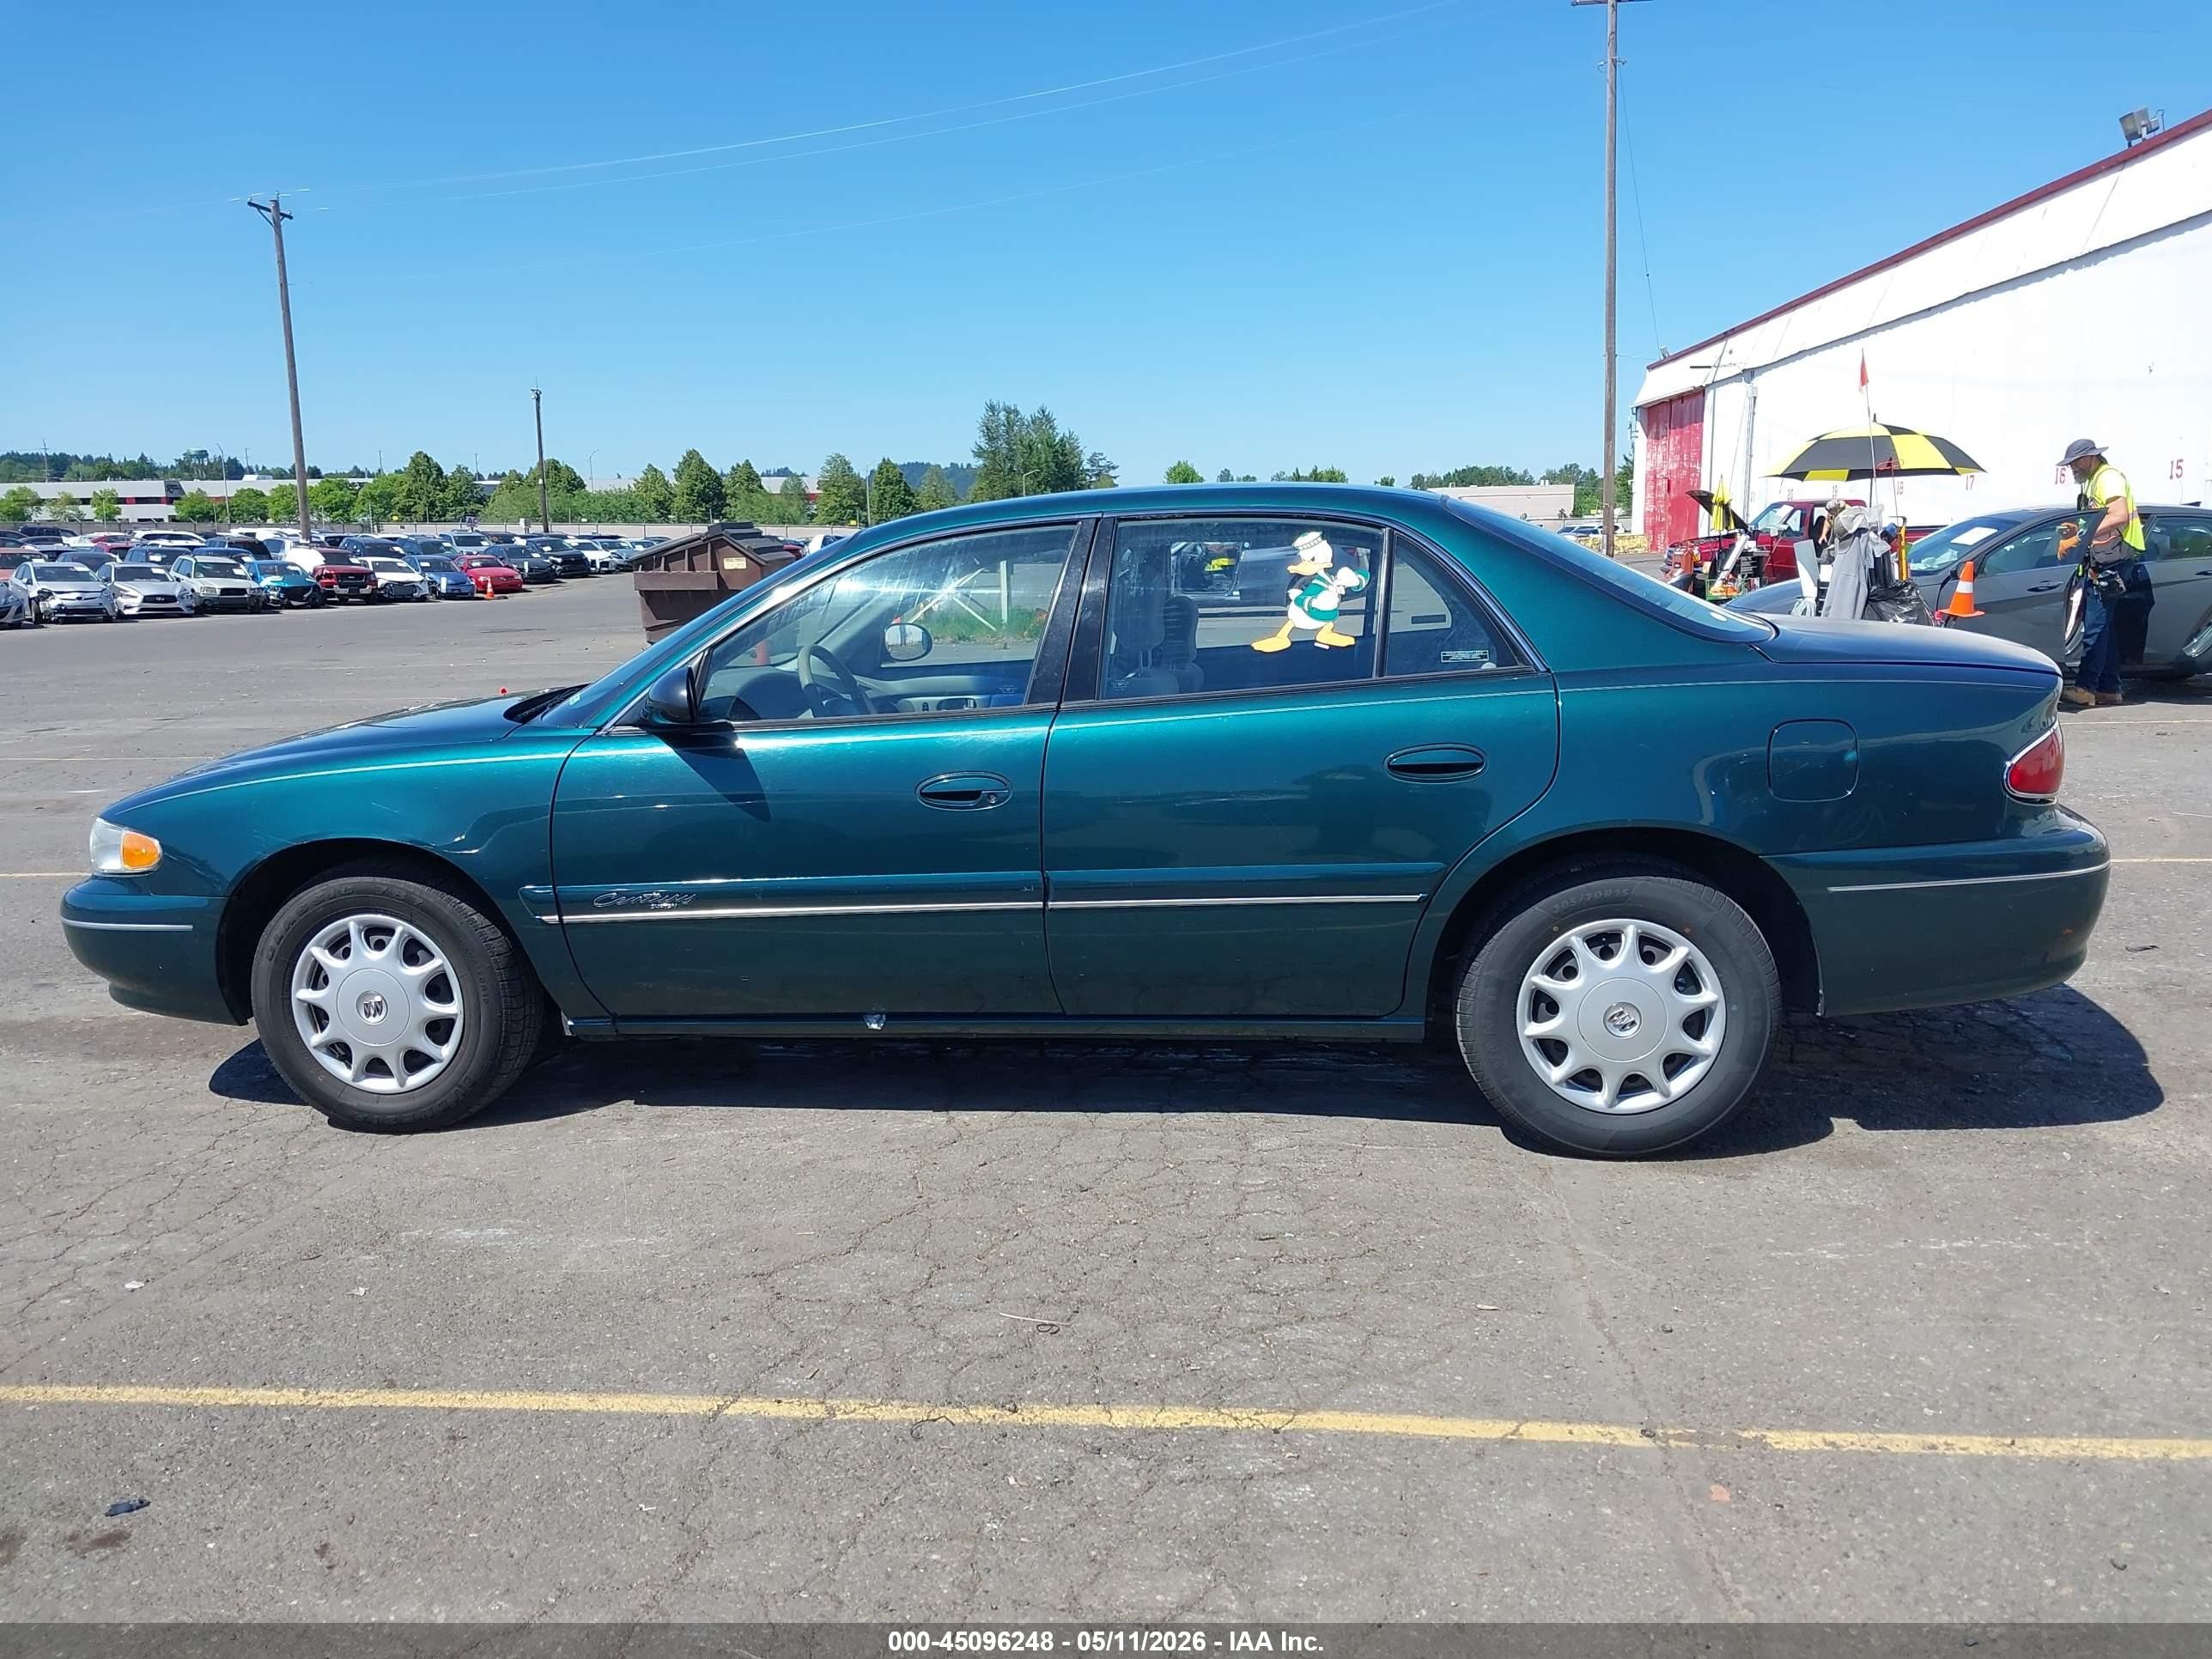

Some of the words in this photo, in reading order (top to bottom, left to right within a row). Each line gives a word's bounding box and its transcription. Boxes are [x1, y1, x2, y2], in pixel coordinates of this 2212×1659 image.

[2055, 466, 2066, 485] 16
[2169, 459, 2185, 480] 15
[1896, 481, 1904, 495] 18
[1966, 475, 1975, 491] 17
[592, 892, 696, 908] Century
